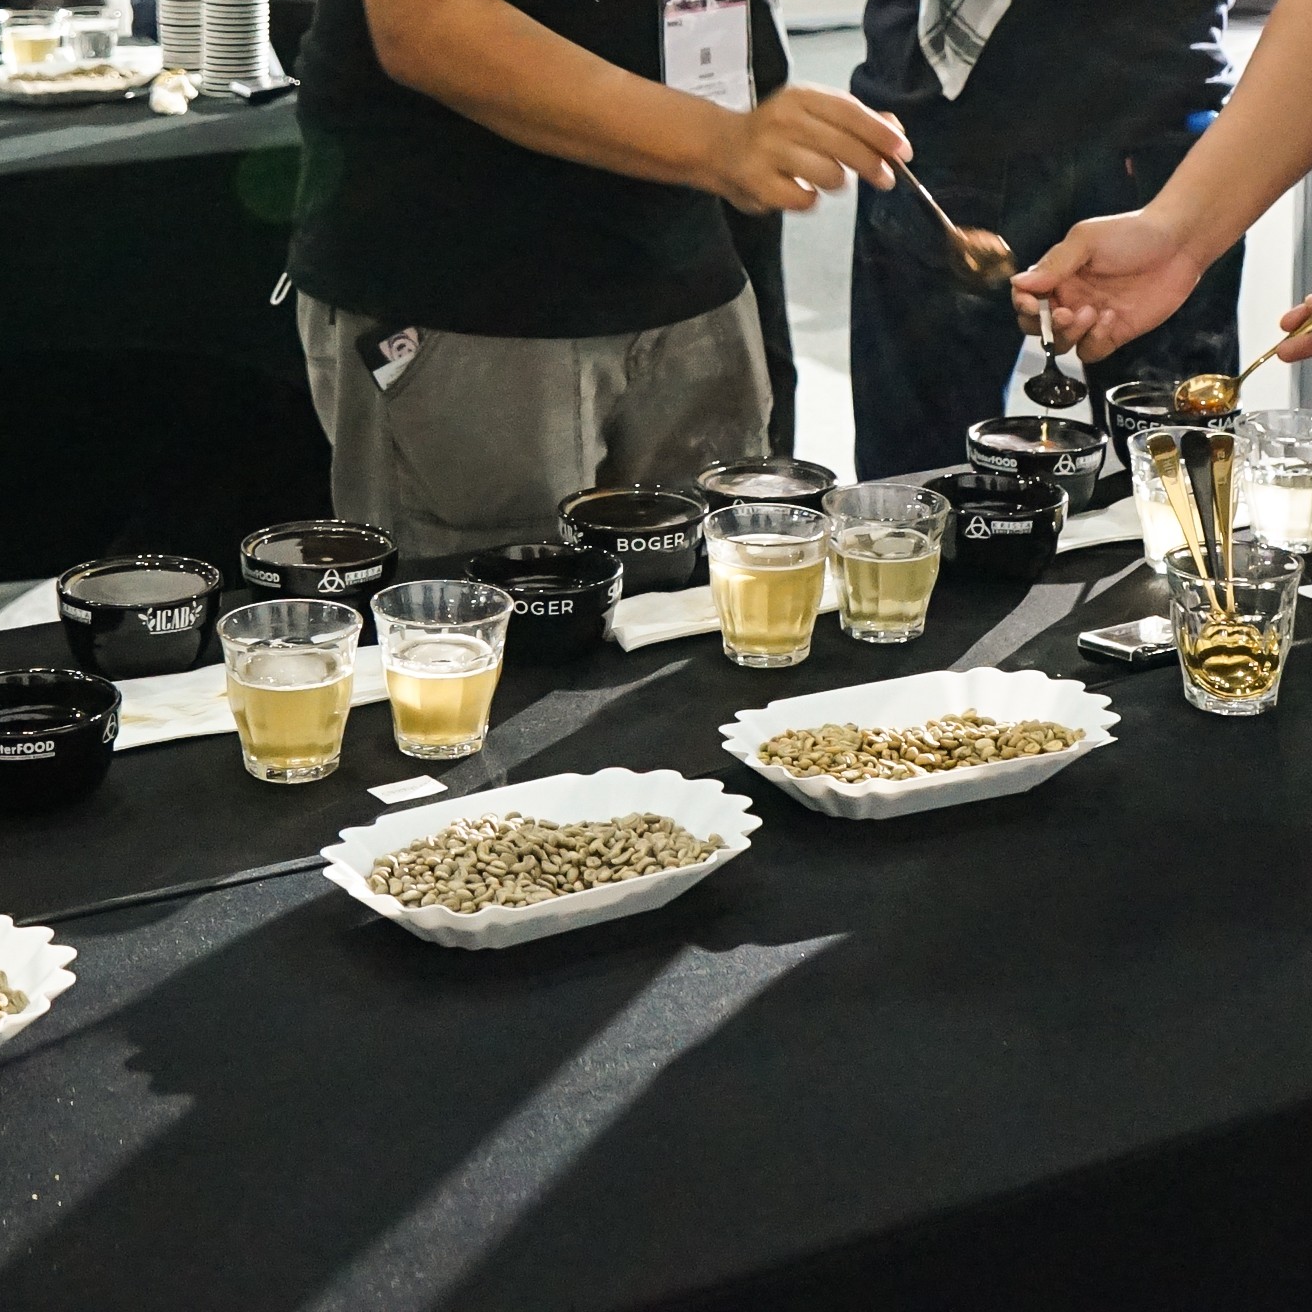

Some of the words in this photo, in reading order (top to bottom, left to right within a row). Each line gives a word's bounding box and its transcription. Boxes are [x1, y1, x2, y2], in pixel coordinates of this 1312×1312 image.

[1116, 414, 1163, 430] BOGE
[617, 532, 685, 552] BOGER
[513, 599, 574, 615] OGER
[156, 606, 190, 631] ICAB
